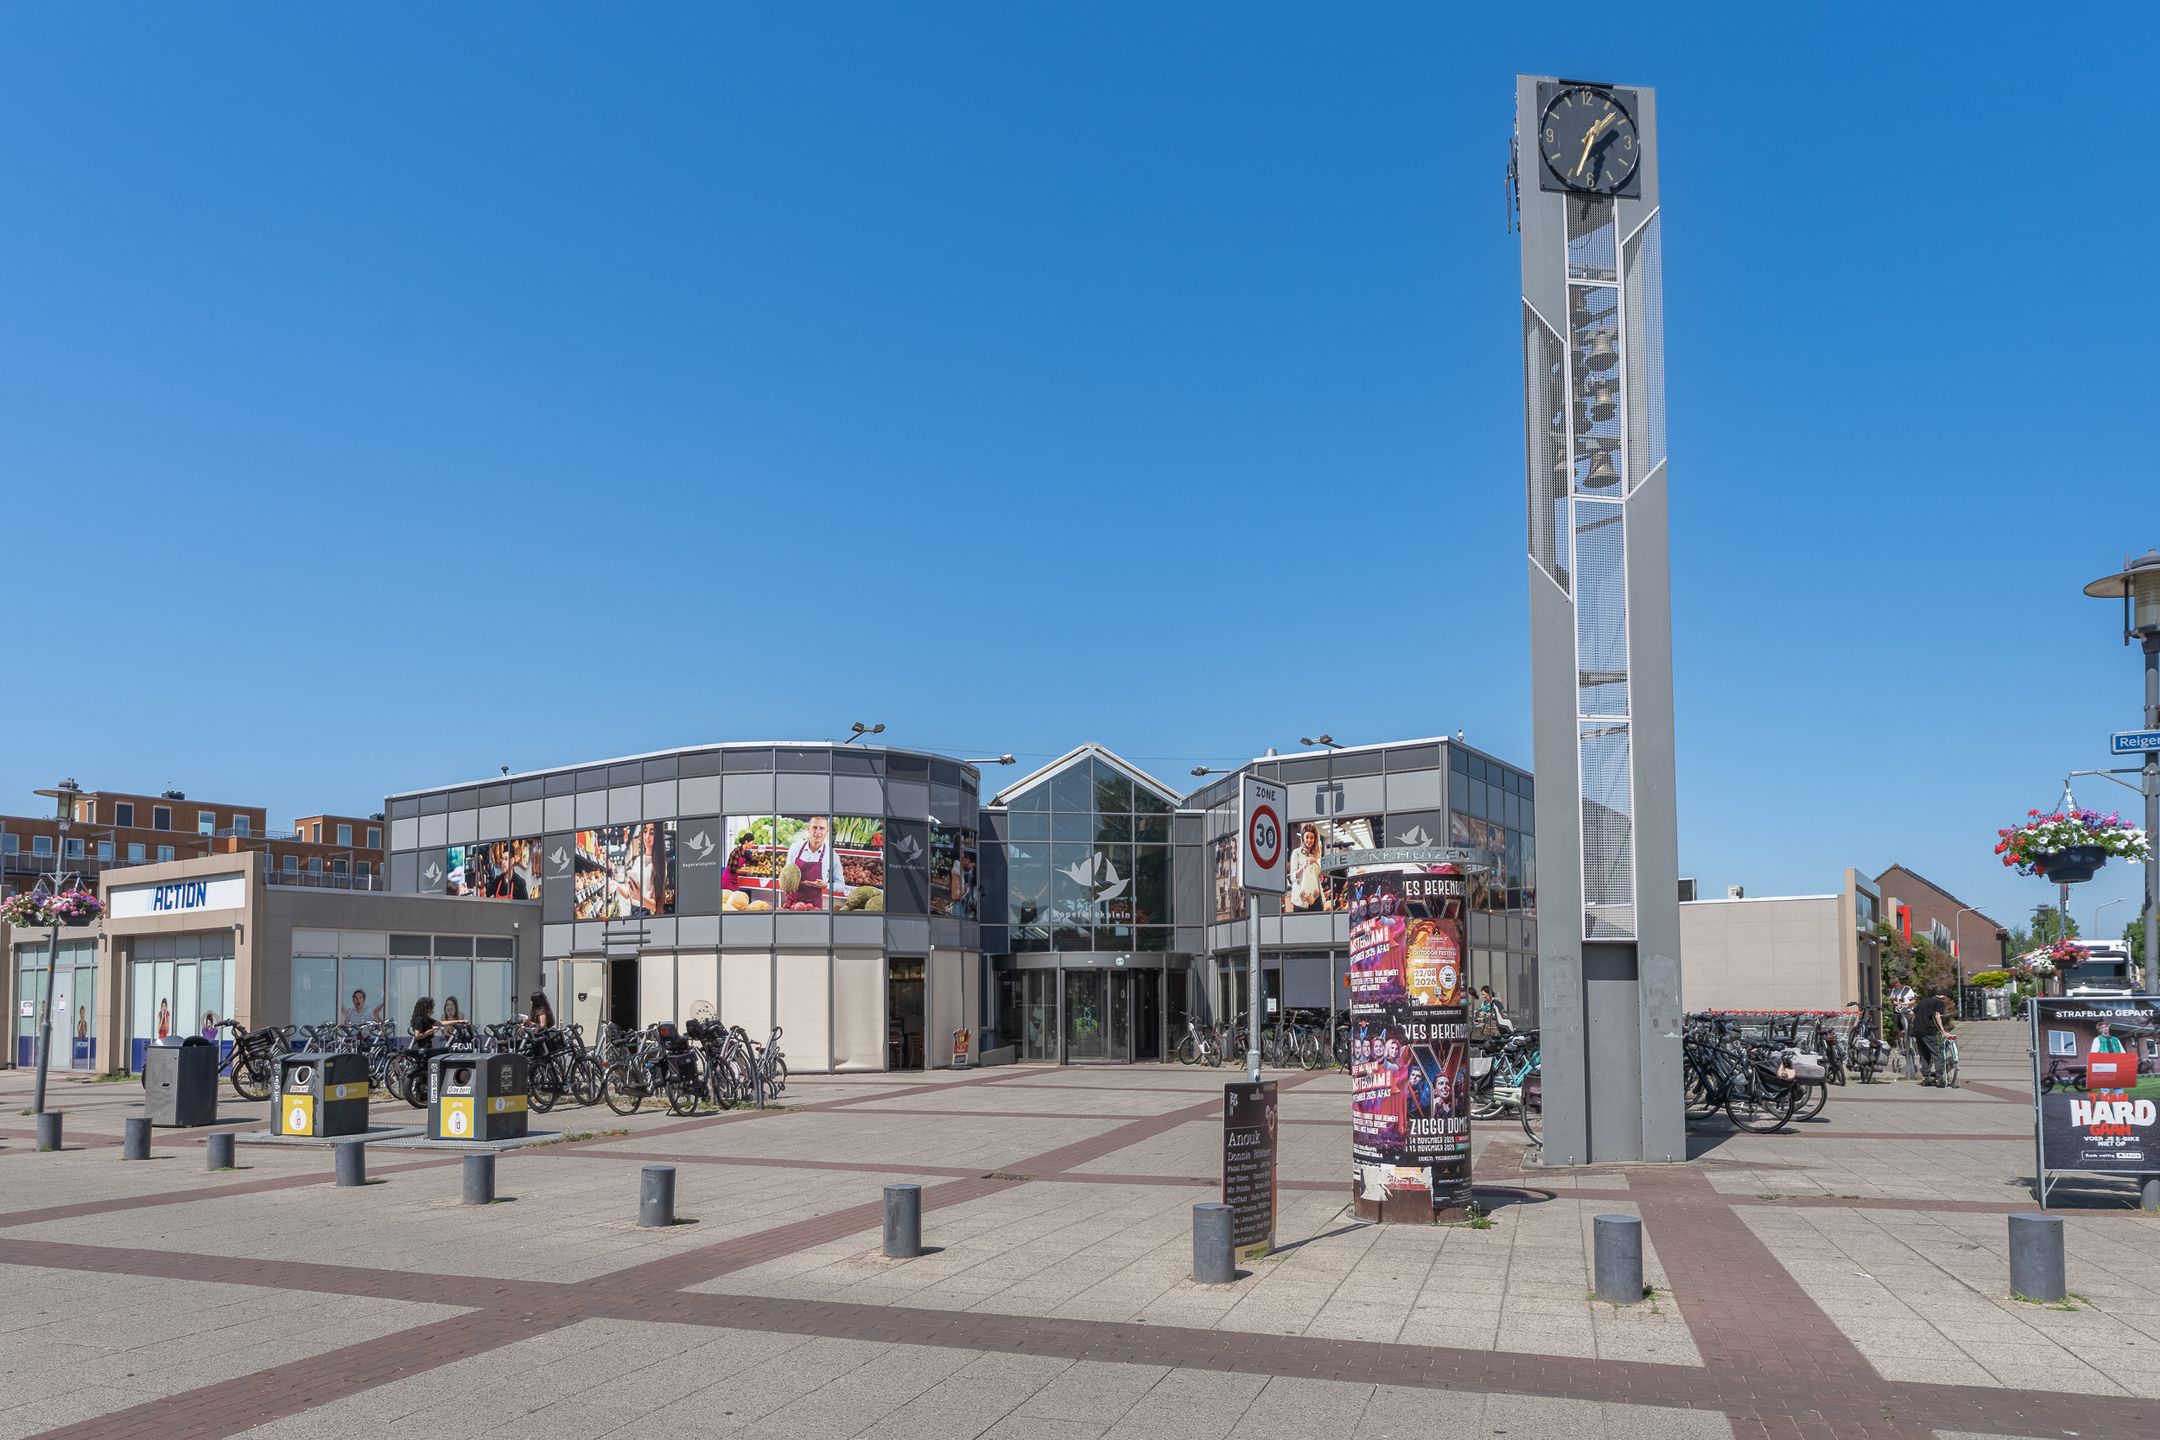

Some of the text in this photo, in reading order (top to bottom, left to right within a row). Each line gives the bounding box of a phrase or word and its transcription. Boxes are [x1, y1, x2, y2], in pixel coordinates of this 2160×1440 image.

[1581, 91, 1593, 106] 12
[1546, 128, 1554, 143] 9
[1624, 136, 1632, 150] 3
[1586, 172, 1594, 187] 6
[1256, 786, 1276, 801] ZONE
[1255, 823, 1276, 849] 30
[1402, 880, 1420, 896] ES
[153, 881, 207, 911] ACTION
[1053, 910, 1131, 920] Koperiekplein
[1414, 969, 1436, 977] 22/08
[1415, 978, 1437, 986] 2026
[2056, 1009, 2154, 1018] STRAFBLAD GEPAKT
[1377, 1088, 1391, 1098] AFAS
[2069, 1099, 2157, 1128] HARD
[1410, 1117, 1468, 1135] ZIGGO DOME
[2088, 1122, 2132, 1136] GAAN
[1227, 1130, 1261, 1146] Anouk
[1417, 1136, 1443, 1144] NOVEMBER
[1417, 1144, 1443, 1152] NOVEMBER
